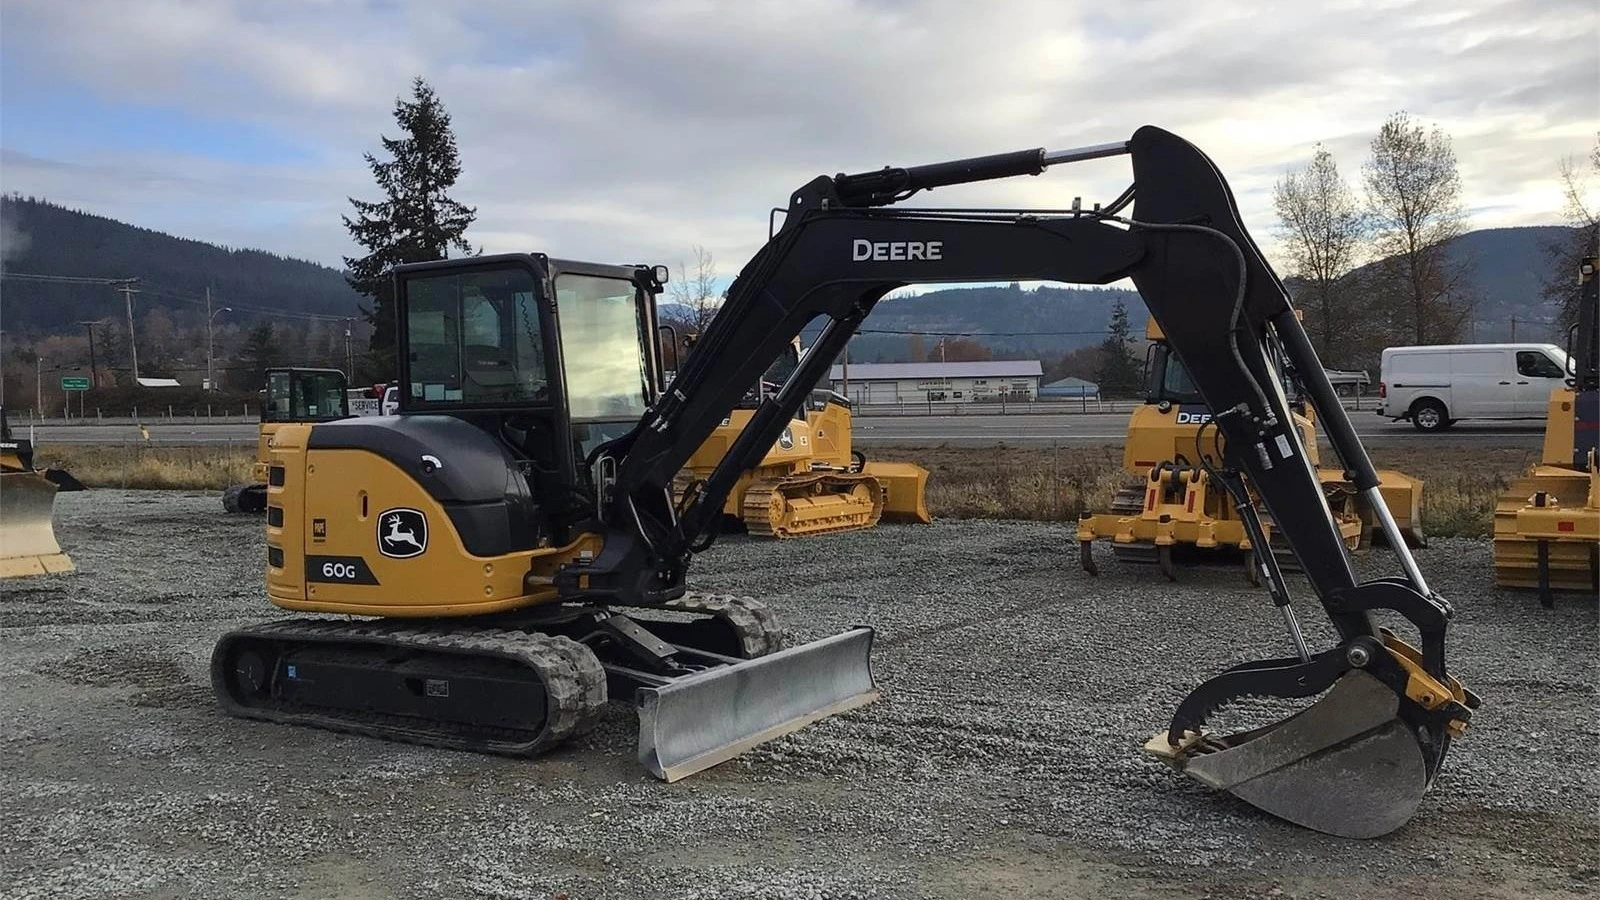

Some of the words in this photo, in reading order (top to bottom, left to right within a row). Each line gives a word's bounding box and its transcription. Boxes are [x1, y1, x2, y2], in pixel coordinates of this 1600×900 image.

[853, 239, 943, 261] DEERE
[1177, 412, 1215, 424] DEE
[322, 562, 356, 579] 60G
